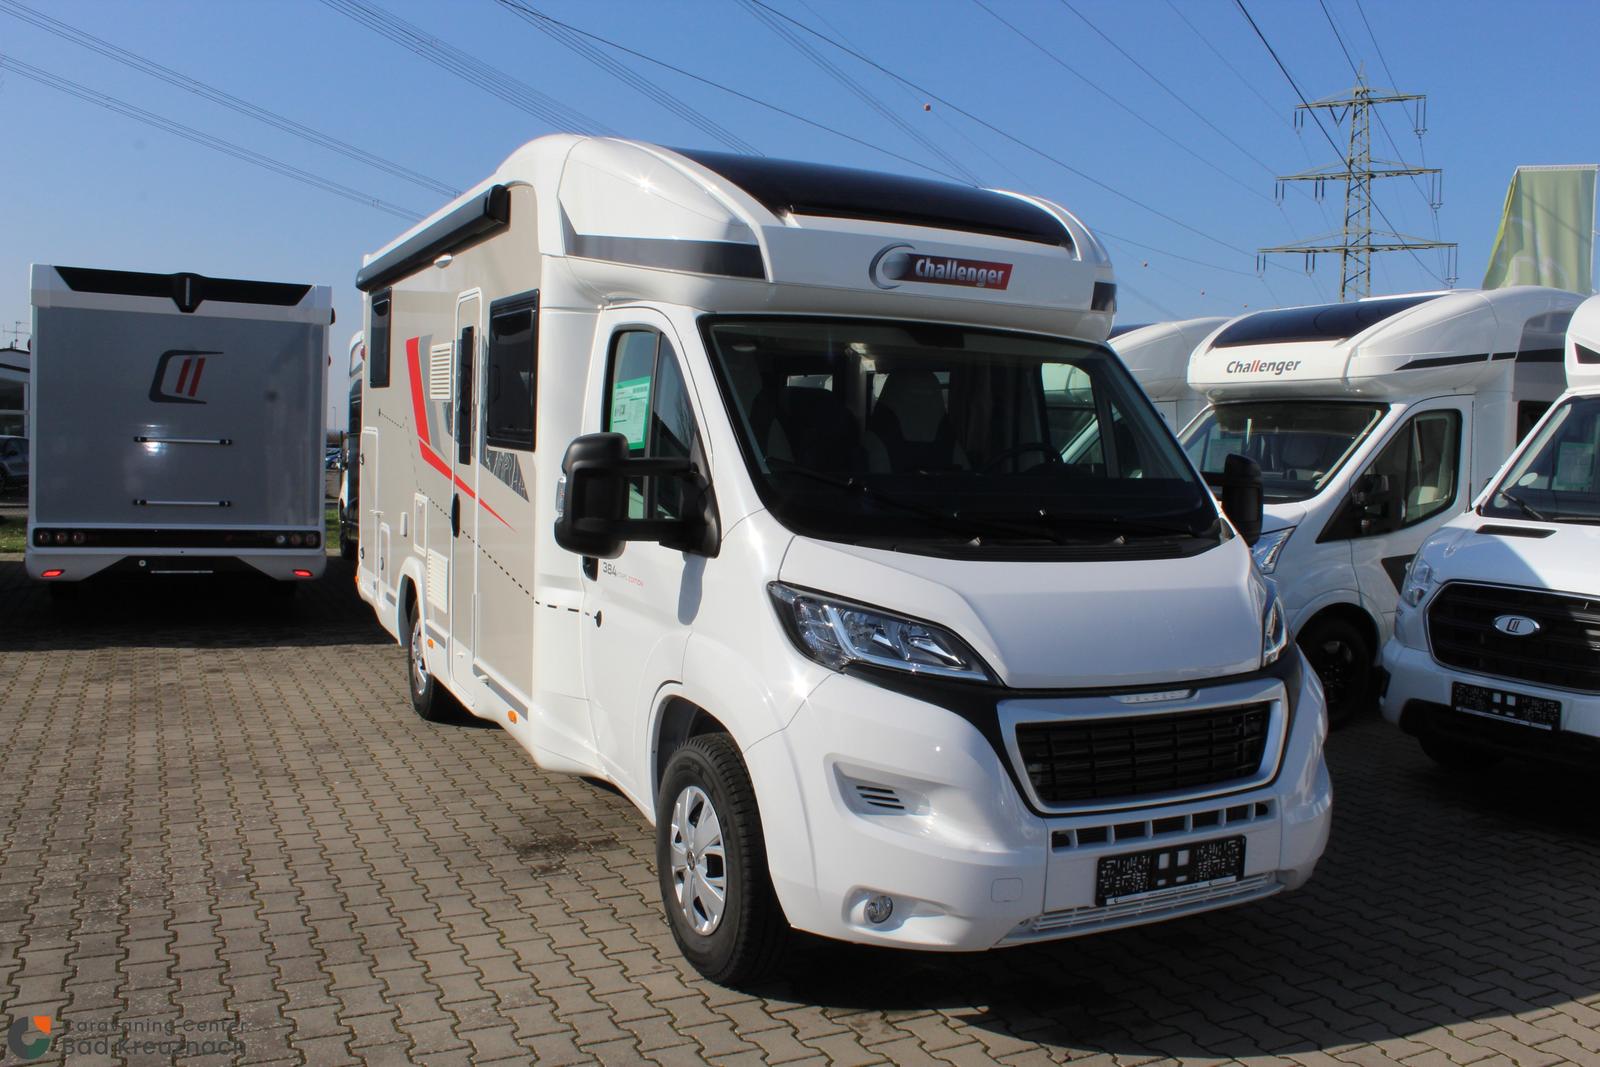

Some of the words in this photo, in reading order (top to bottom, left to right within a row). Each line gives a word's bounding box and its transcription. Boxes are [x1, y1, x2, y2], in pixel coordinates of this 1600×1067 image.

[915, 257, 1005, 287] Challenger
[1226, 359, 1301, 375] Challenger
[602, 561, 617, 577] 384
